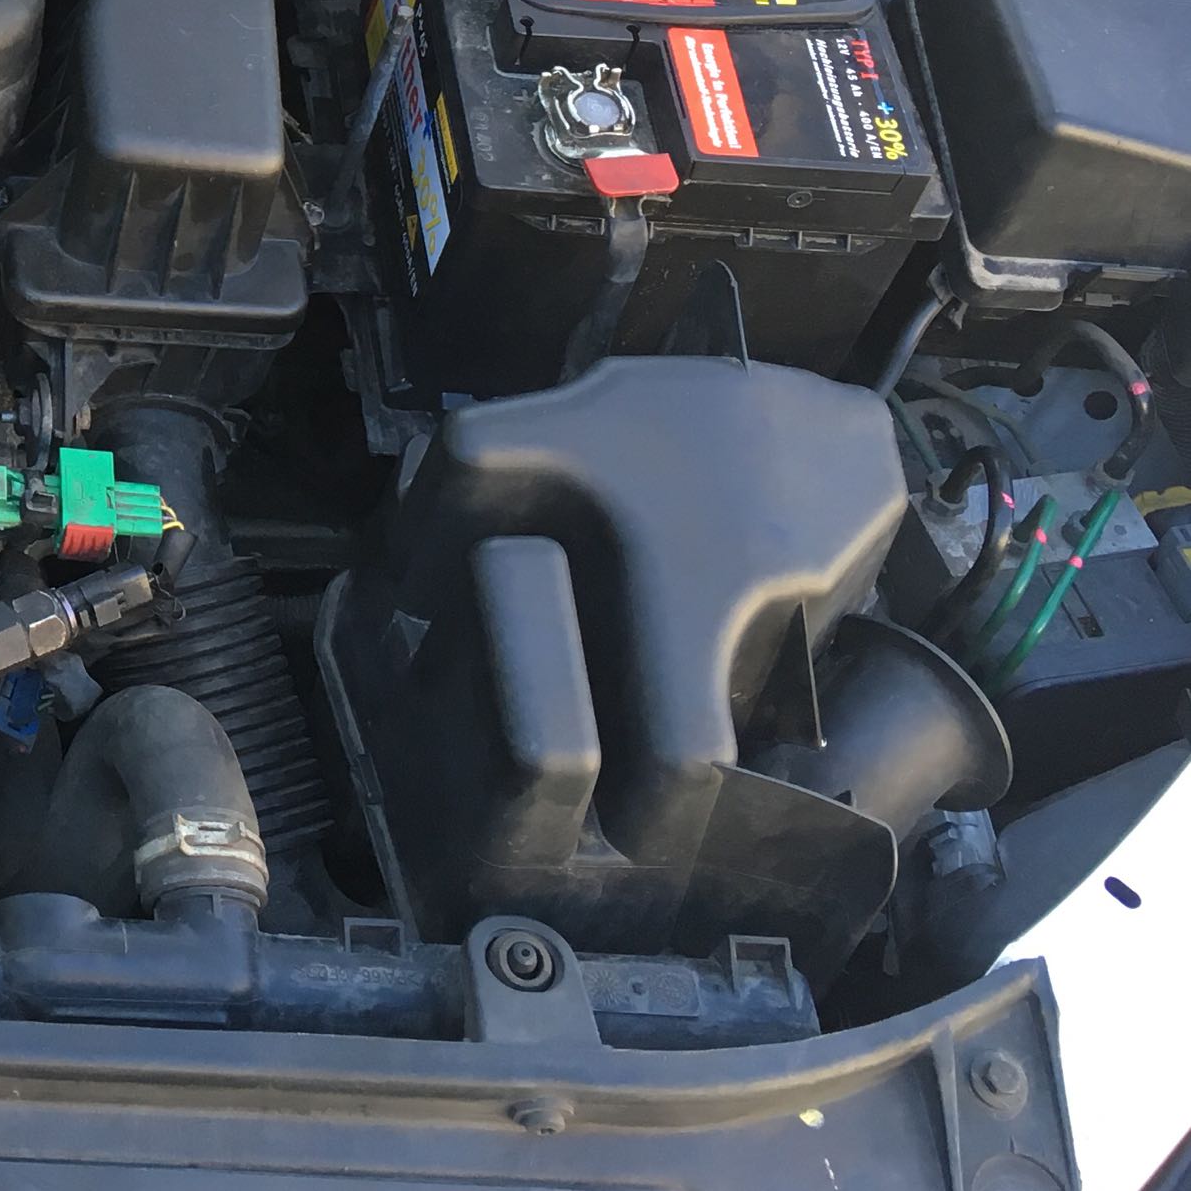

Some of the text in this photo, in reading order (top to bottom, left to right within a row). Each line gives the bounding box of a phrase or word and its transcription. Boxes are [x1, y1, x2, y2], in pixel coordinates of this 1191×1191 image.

[701, 42, 722, 79] Energie
[712, 80, 725, 91] in
[850, 39, 875, 69] TYP
[815, 38, 860, 159] Hochleistungsbatterie
[835, 38, 883, 159] 12V 45 Ah 400 A/EN
